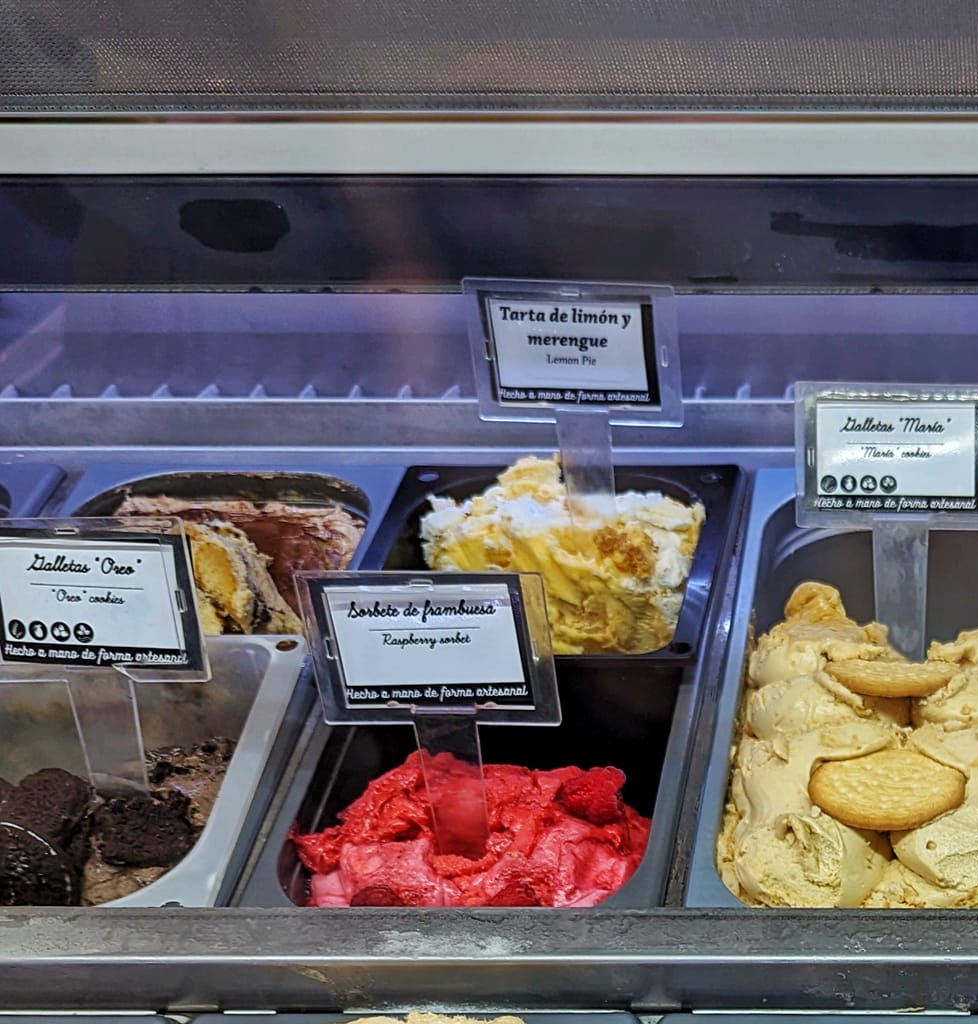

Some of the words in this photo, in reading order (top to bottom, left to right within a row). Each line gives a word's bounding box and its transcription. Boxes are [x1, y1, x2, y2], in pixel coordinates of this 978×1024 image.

[500, 307, 546, 322] Tarta
[550, 308, 568, 323] de
[572, 309, 618, 324] limón
[621, 315, 631, 329] y
[528, 334, 608, 351] merengue
[547, 354, 579, 365] Lemon
[582, 356, 596, 366] Pie
[500, 389, 526, 399] Hecho
[537, 392, 563, 400] mano
[564, 391, 575, 400] de
[576, 391, 606, 404] forma
[608, 392, 649, 402] artesanal
[840, 416, 894, 432] Galletas
[814, 498, 843, 508] Hecho
[855, 500, 882, 508] mano
[884, 498, 896, 508] de
[897, 498, 927, 511] forma
[930, 499, 976, 509] artesanal
[27, 554, 90, 572] Galletas
[89, 592, 125, 604] cookies
[347, 601, 400, 618] Sorbete
[403, 602, 419, 616] de
[422, 599, 496, 623] frambuesa
[382, 633, 437, 649] Raspberry
[439, 634, 471, 645] sorbet
[5, 644, 36, 656] Hecho
[48, 649, 79, 658] mano
[81, 649, 96, 659] de
[97, 648, 134, 664] forma
[346, 688, 379, 699] Hecho
[392, 690, 422, 698] mano
[424, 687, 439, 698] de
[440, 686, 474, 701] forma
[476, 686, 528, 696] artesanal
